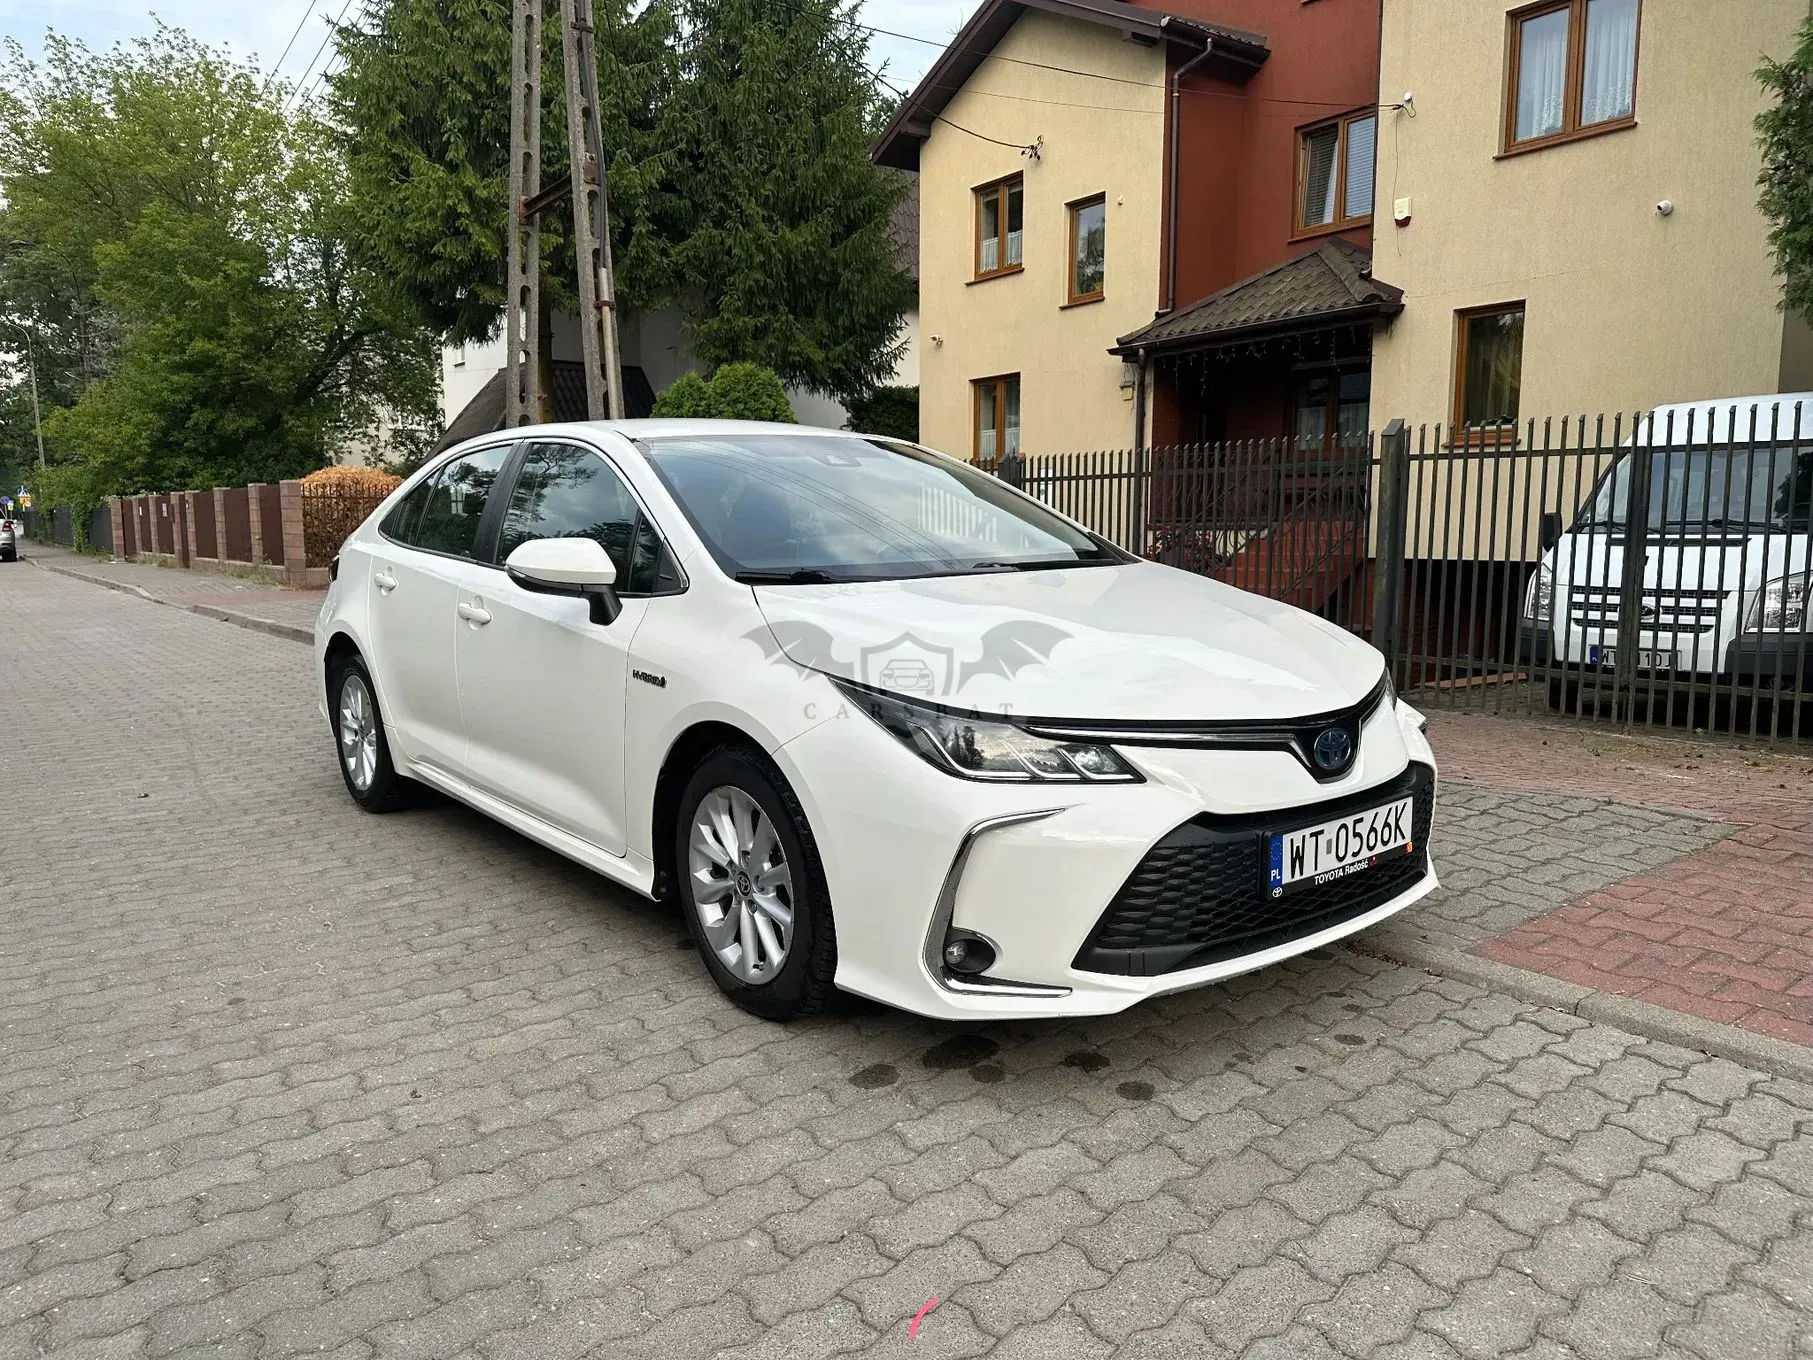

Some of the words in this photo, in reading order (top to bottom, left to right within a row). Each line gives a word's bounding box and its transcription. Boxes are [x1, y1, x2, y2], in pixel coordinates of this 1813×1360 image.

[632, 669, 661, 687] HYBRID
[1290, 830, 1325, 879] WT
[1335, 802, 1407, 862] 0566K
[1270, 868, 1281, 881] PL
[1314, 869, 1344, 885] TOYOTA
